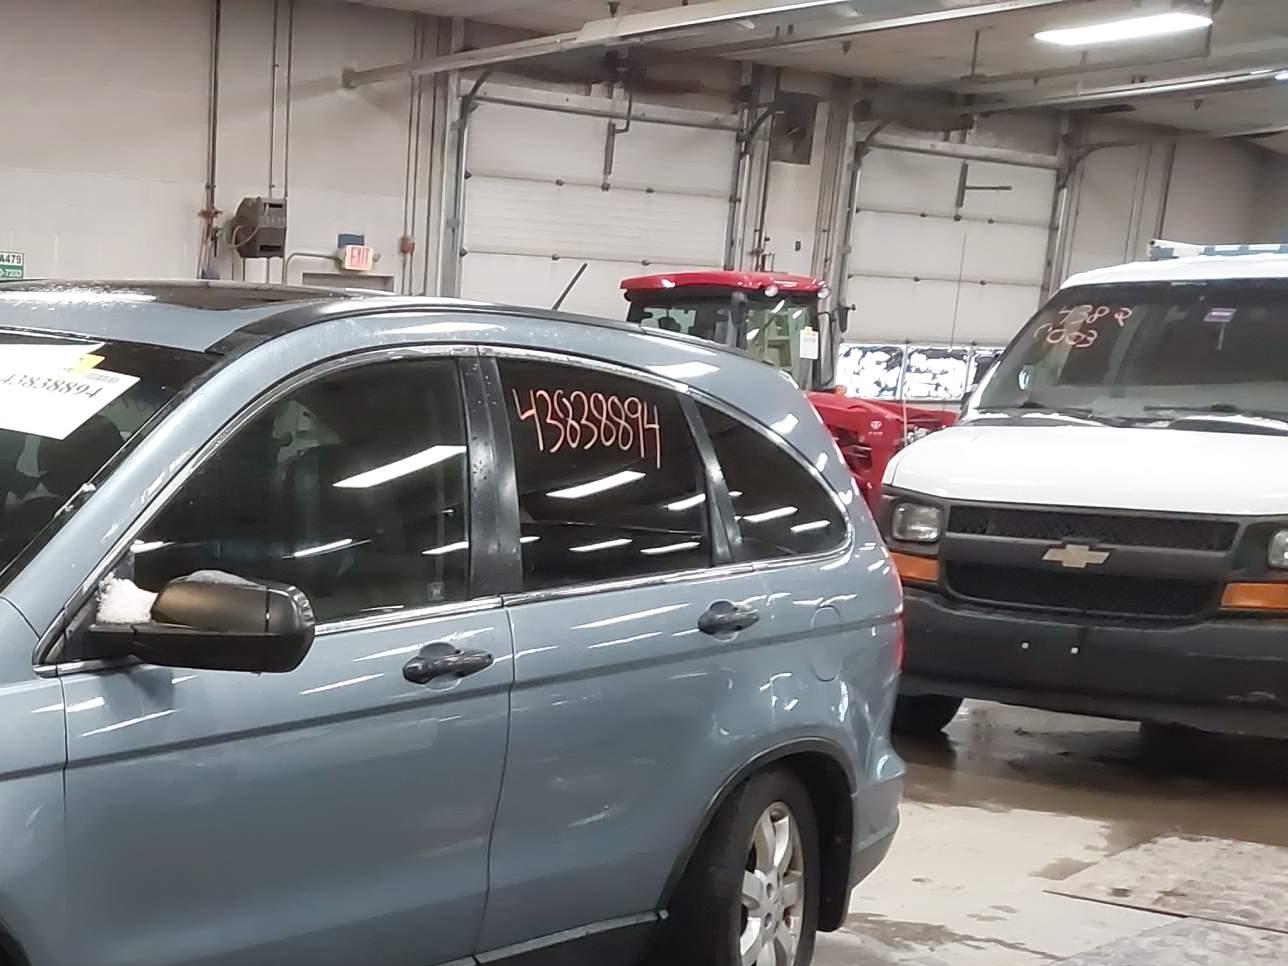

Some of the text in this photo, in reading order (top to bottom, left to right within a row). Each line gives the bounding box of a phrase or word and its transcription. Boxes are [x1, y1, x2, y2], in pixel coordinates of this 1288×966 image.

[349, 247, 370, 264] EXIT
[0, 372, 104, 400] 43838894
[512, 388, 662, 470] 43838894
